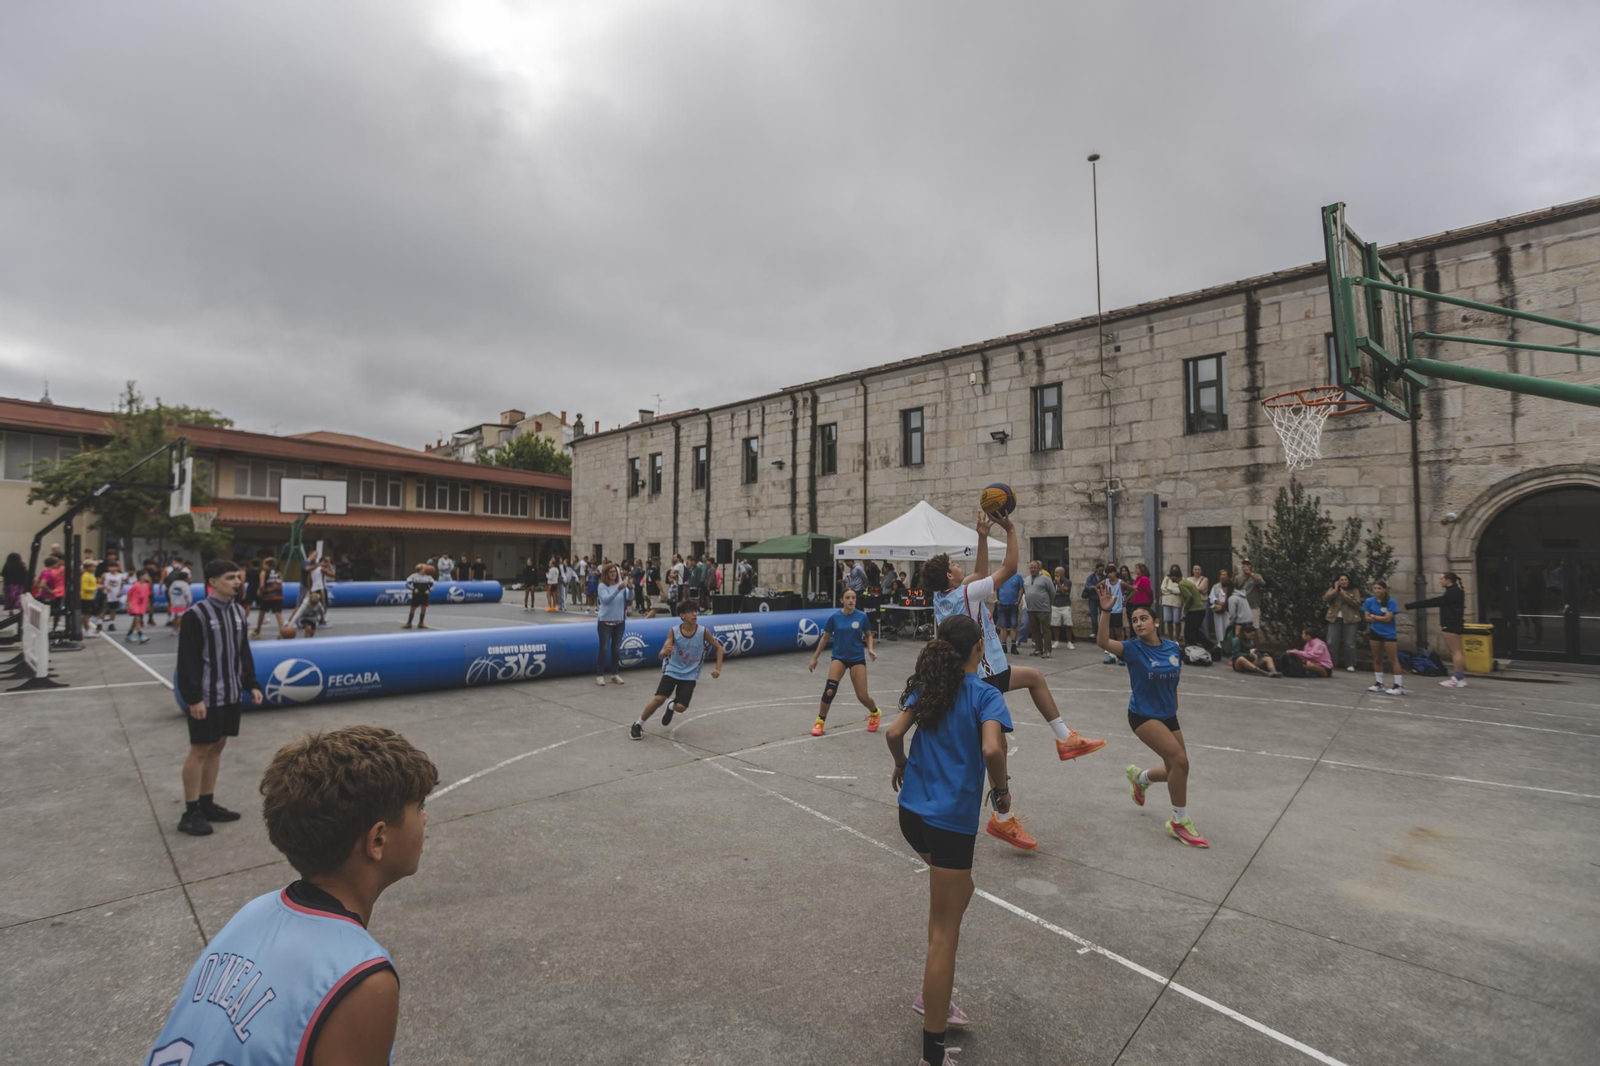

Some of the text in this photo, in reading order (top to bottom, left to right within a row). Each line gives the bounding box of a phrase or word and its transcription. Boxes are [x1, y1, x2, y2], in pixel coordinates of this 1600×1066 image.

[487, 643, 547, 655] CIRCUITO BÁSQUET
[328, 671, 381, 687] FEGABA
[192, 952, 277, 1044] O'NEAL
